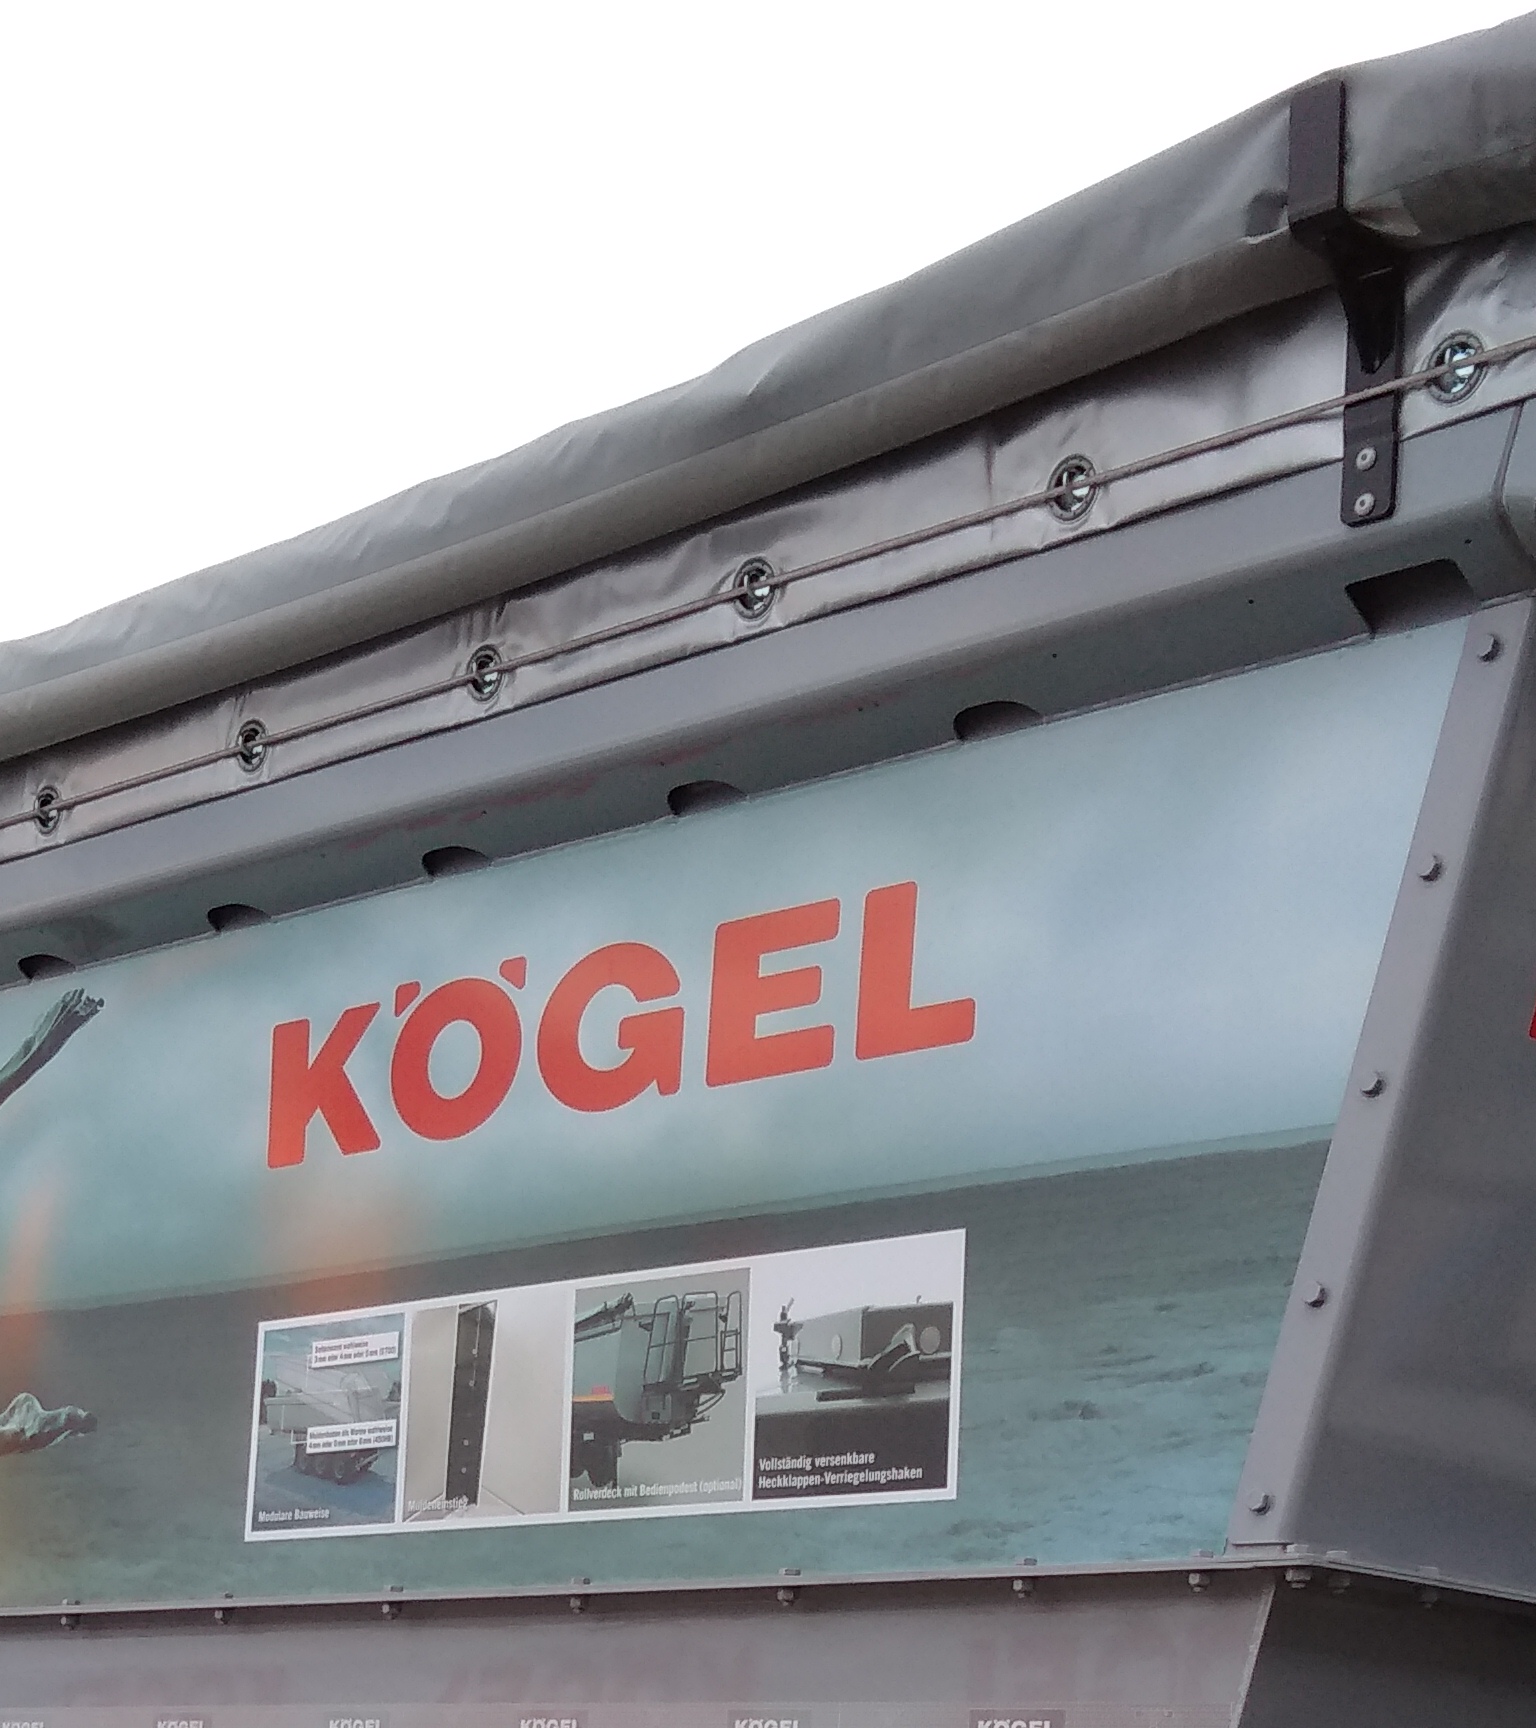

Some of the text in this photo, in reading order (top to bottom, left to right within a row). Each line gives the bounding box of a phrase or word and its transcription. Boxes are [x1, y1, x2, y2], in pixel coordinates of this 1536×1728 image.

[267, 881, 976, 1169] KÖGEL
[759, 1452, 876, 1471] Vollständig versenkbare
[573, 1487, 622, 1501] Rollverdeck
[623, 1485, 638, 1497] mit
